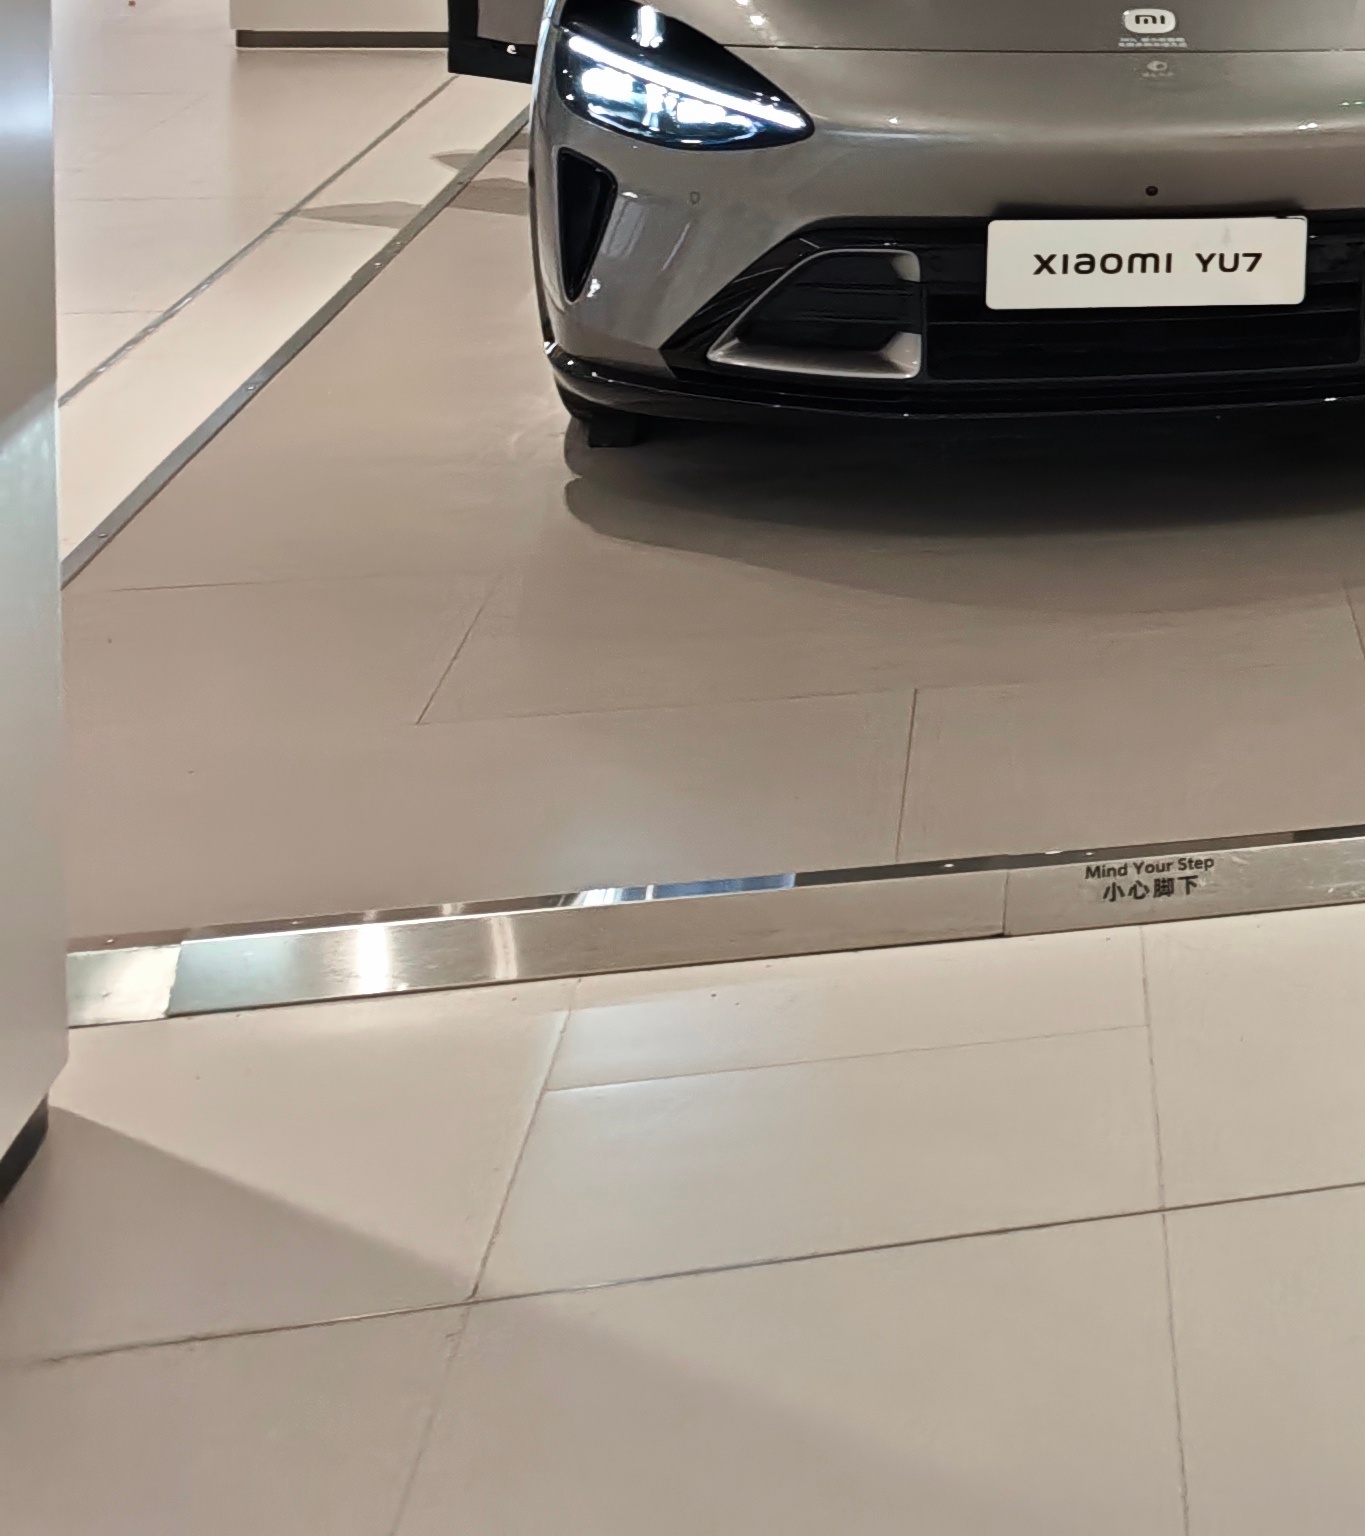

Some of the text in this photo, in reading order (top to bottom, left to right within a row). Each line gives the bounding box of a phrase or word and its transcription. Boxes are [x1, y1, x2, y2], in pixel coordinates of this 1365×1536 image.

[1195, 252, 1263, 273] YU7
[1085, 857, 1215, 880] Mind Your Step
[1103, 875, 1199, 902] 小心脚下
